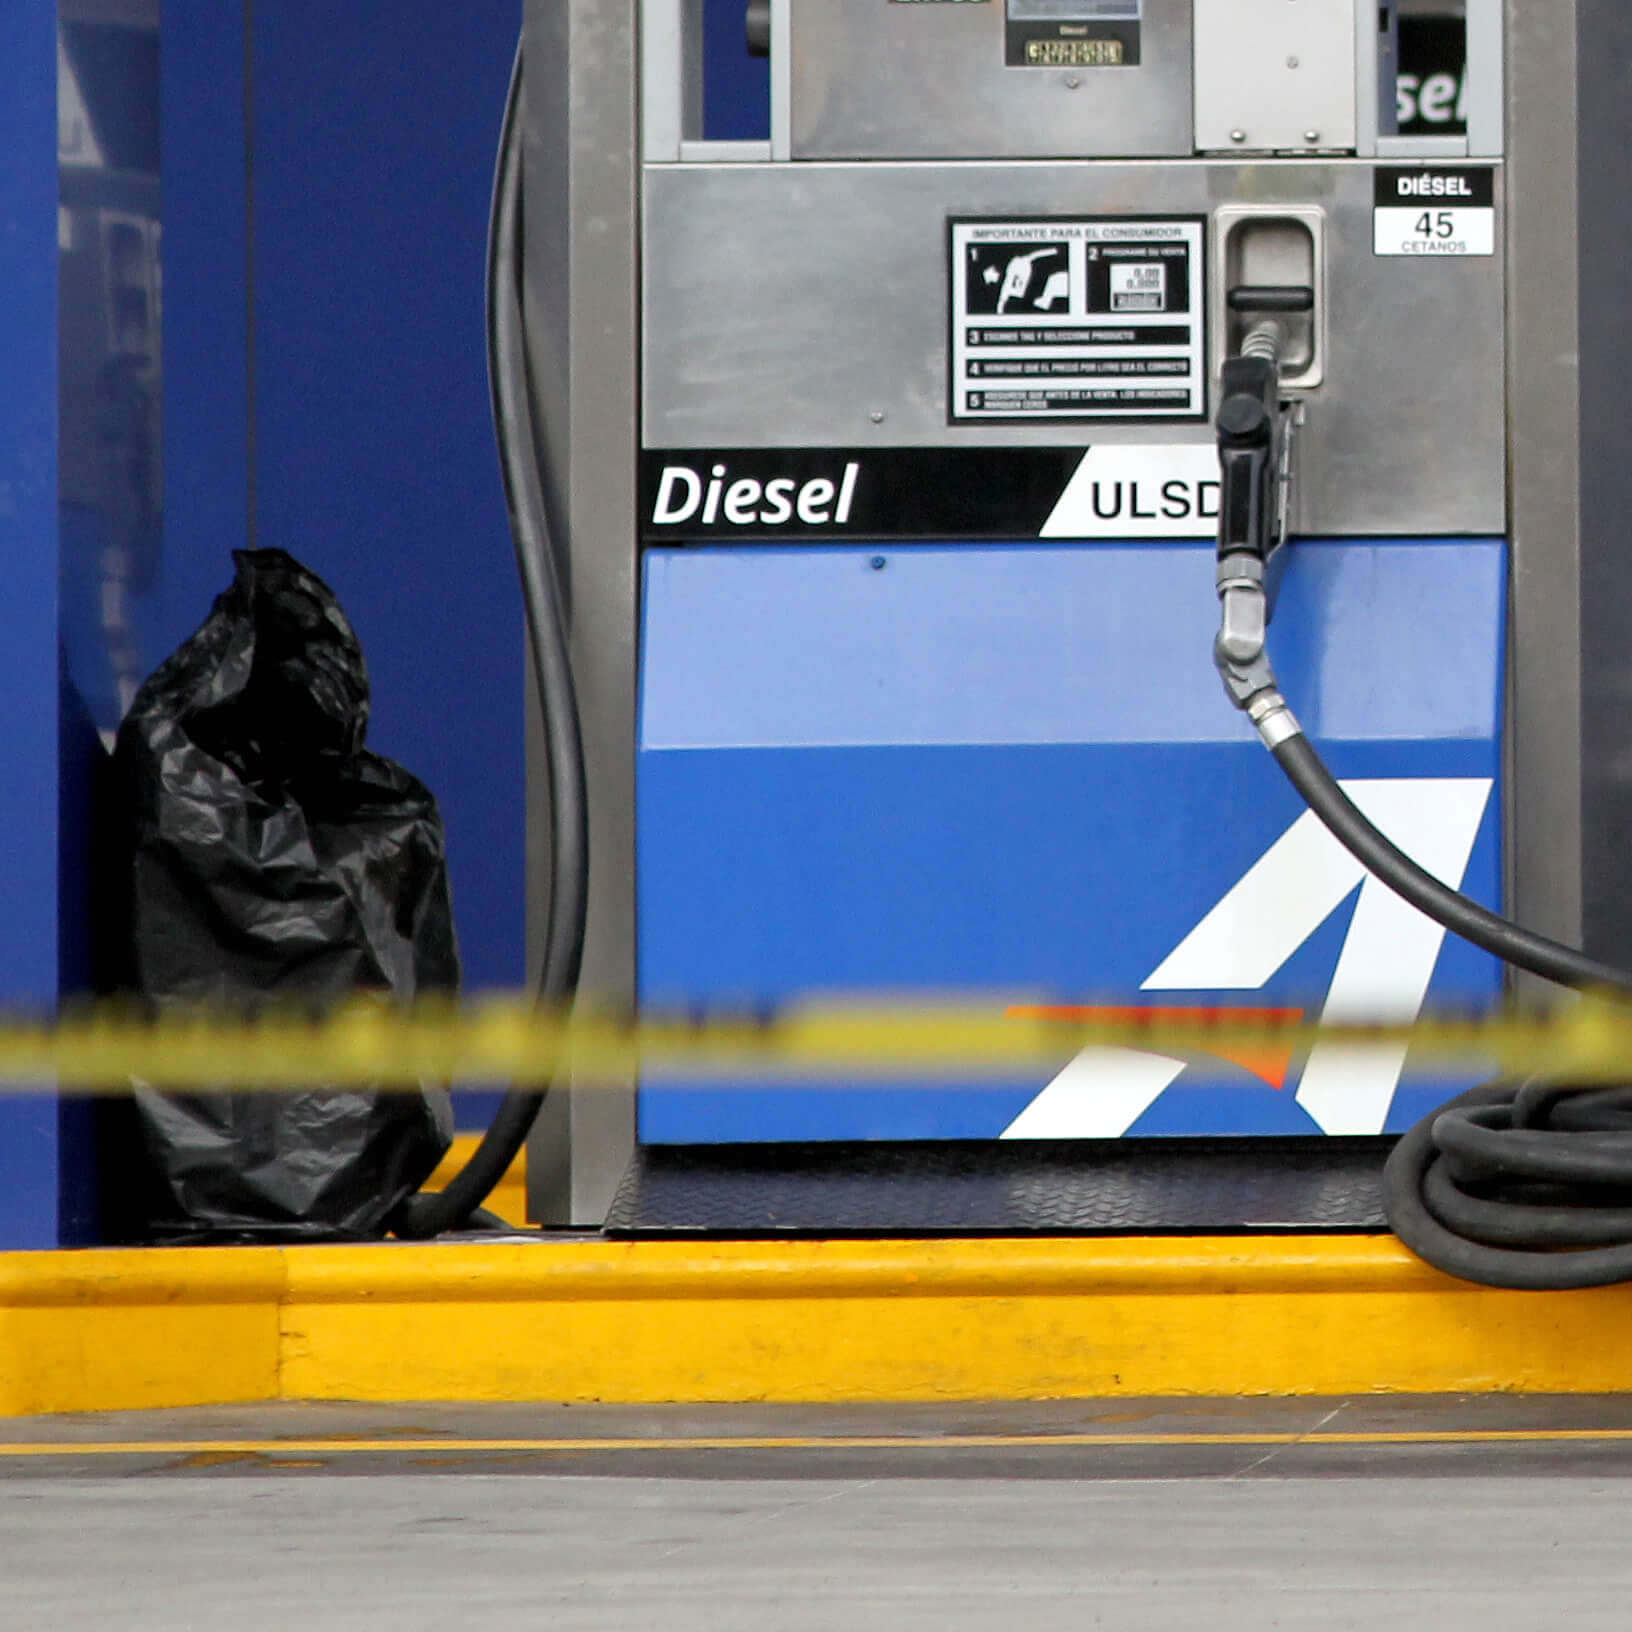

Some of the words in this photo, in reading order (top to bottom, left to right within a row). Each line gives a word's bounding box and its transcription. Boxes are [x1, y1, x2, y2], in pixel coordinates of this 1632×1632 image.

[1398, 174, 1472, 196] DIÉSEL
[1415, 212, 1454, 239] 45
[972, 228, 1046, 240] IMPORTANTE
[1050, 228, 1081, 239] PARA
[1085, 228, 1099, 238] EL
[1401, 241, 1467, 254] CETANOS
[1088, 248, 1098, 261] 2
[969, 330, 979, 343] 3
[969, 362, 979, 375] 4
[652, 462, 859, 526] Diesel
